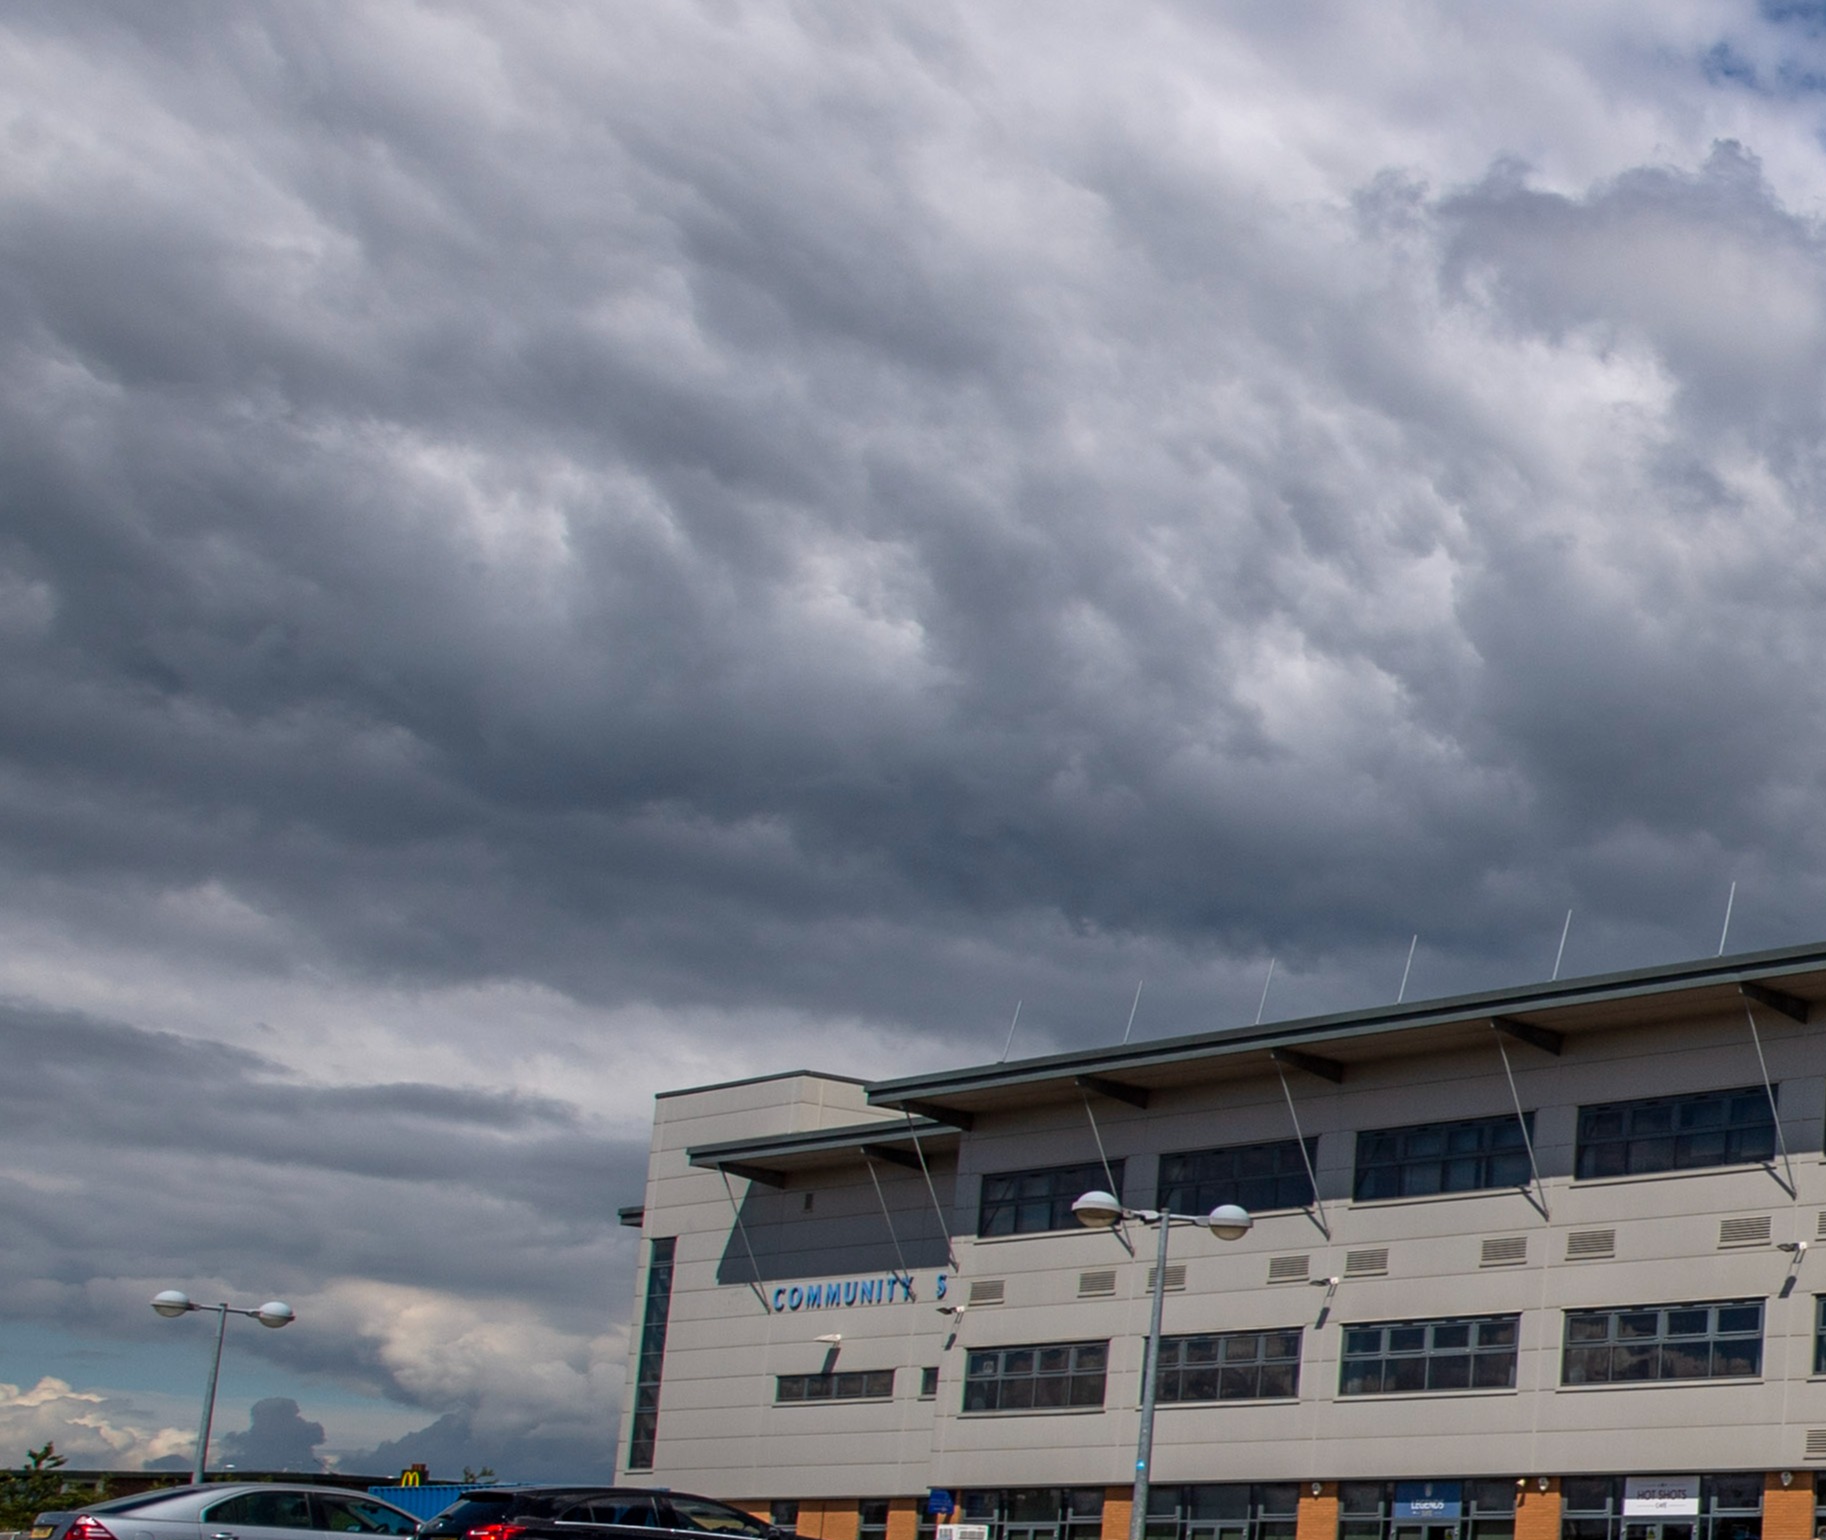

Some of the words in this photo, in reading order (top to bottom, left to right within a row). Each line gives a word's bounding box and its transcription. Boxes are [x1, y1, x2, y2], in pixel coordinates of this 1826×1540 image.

[772, 1275, 915, 1312] COMMUNITY
[936, 1271, 948, 1300] S
[1637, 1490, 1655, 1500] HOT
[1658, 1489, 1687, 1500] SHOTS
